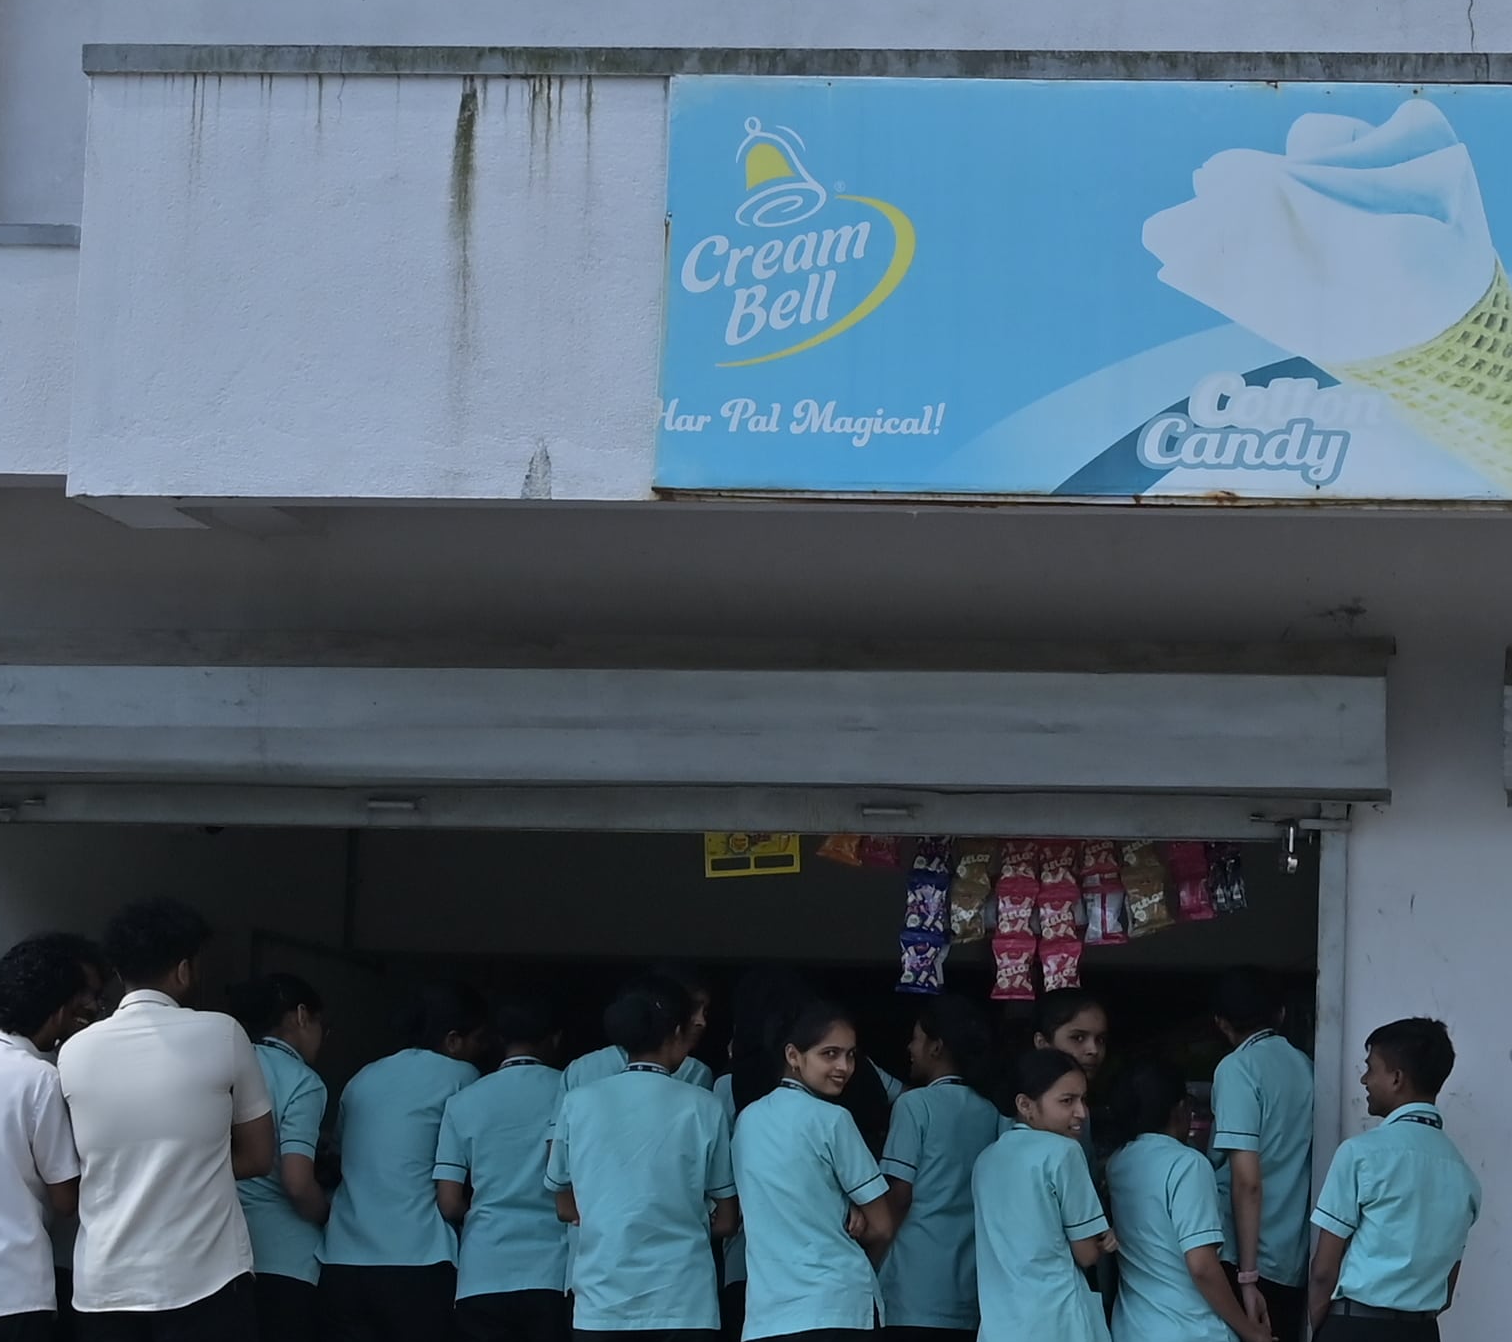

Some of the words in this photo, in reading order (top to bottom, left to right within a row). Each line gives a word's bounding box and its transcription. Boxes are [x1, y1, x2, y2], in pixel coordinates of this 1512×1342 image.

[681, 221, 870, 293] Cream
[724, 269, 836, 346] Bell
[719, 397, 781, 433] Pal
[789, 398, 946, 447] Magical!
[1190, 371, 1382, 427] Cotton
[1140, 415, 1348, 484] Candy
